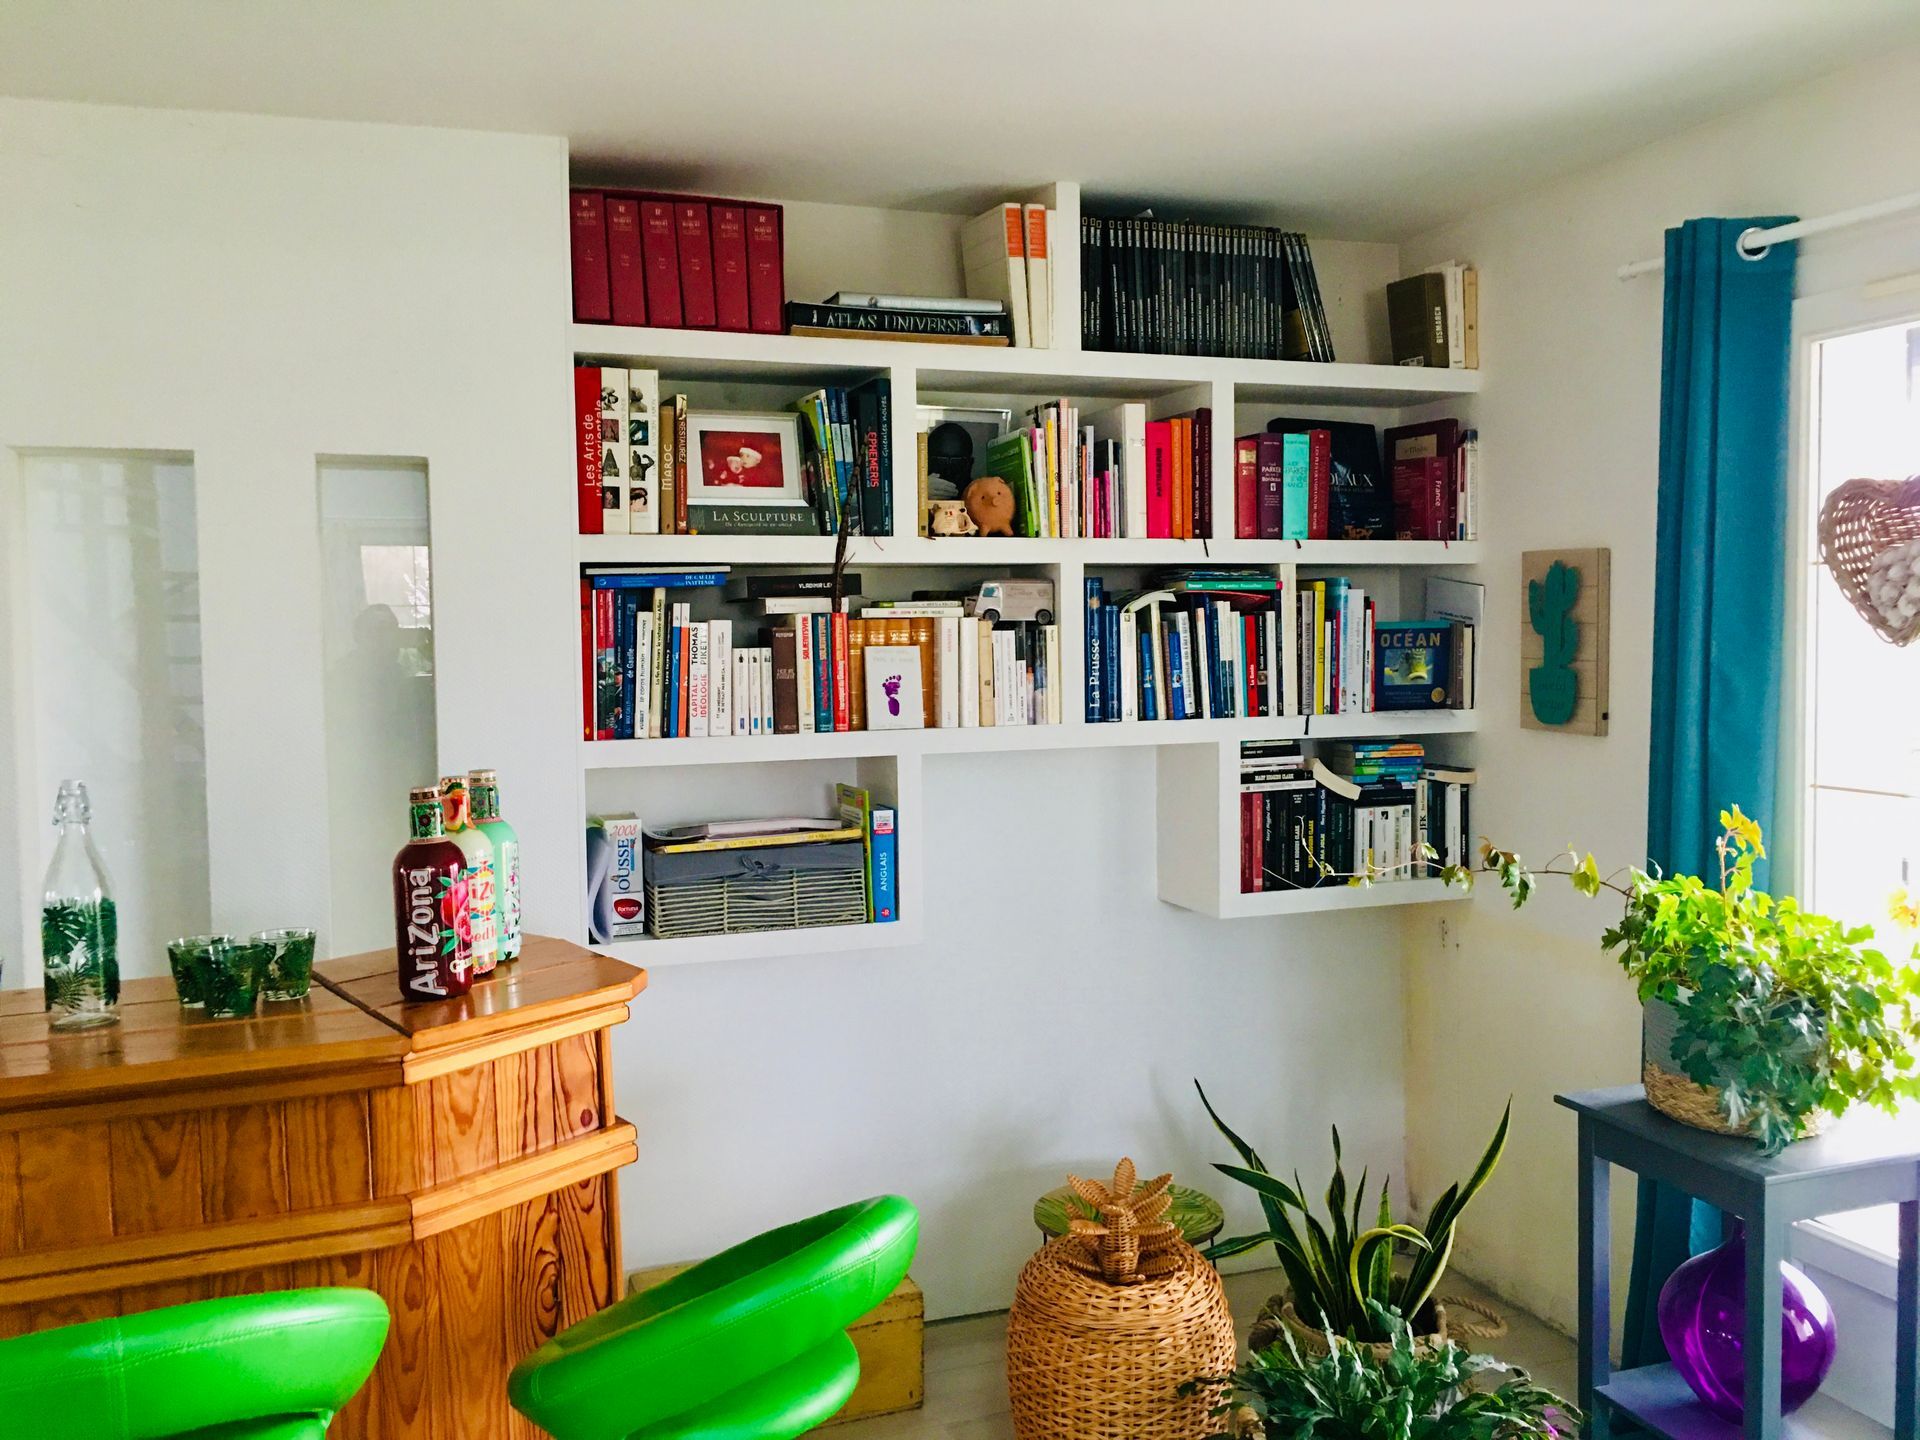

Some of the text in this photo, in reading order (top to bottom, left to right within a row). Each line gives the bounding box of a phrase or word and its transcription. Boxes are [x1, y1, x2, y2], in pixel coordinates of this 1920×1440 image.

[1434, 306, 1444, 343] BISMARCK
[880, 395, 888, 421] noires
[583, 414, 595, 486] Les Arts de
[661, 444, 673, 490] MAROC
[1434, 480, 1442, 507] France
[713, 511, 804, 522] LA SCULPTURE
[1380, 630, 1441, 648] OCÉAN
[627, 670, 634, 678] de
[1089, 638, 1100, 708] La Prusse
[610, 824, 637, 837] 2008
[617, 838, 630, 891] OUSSE
[408, 868, 448, 996] AriZona
